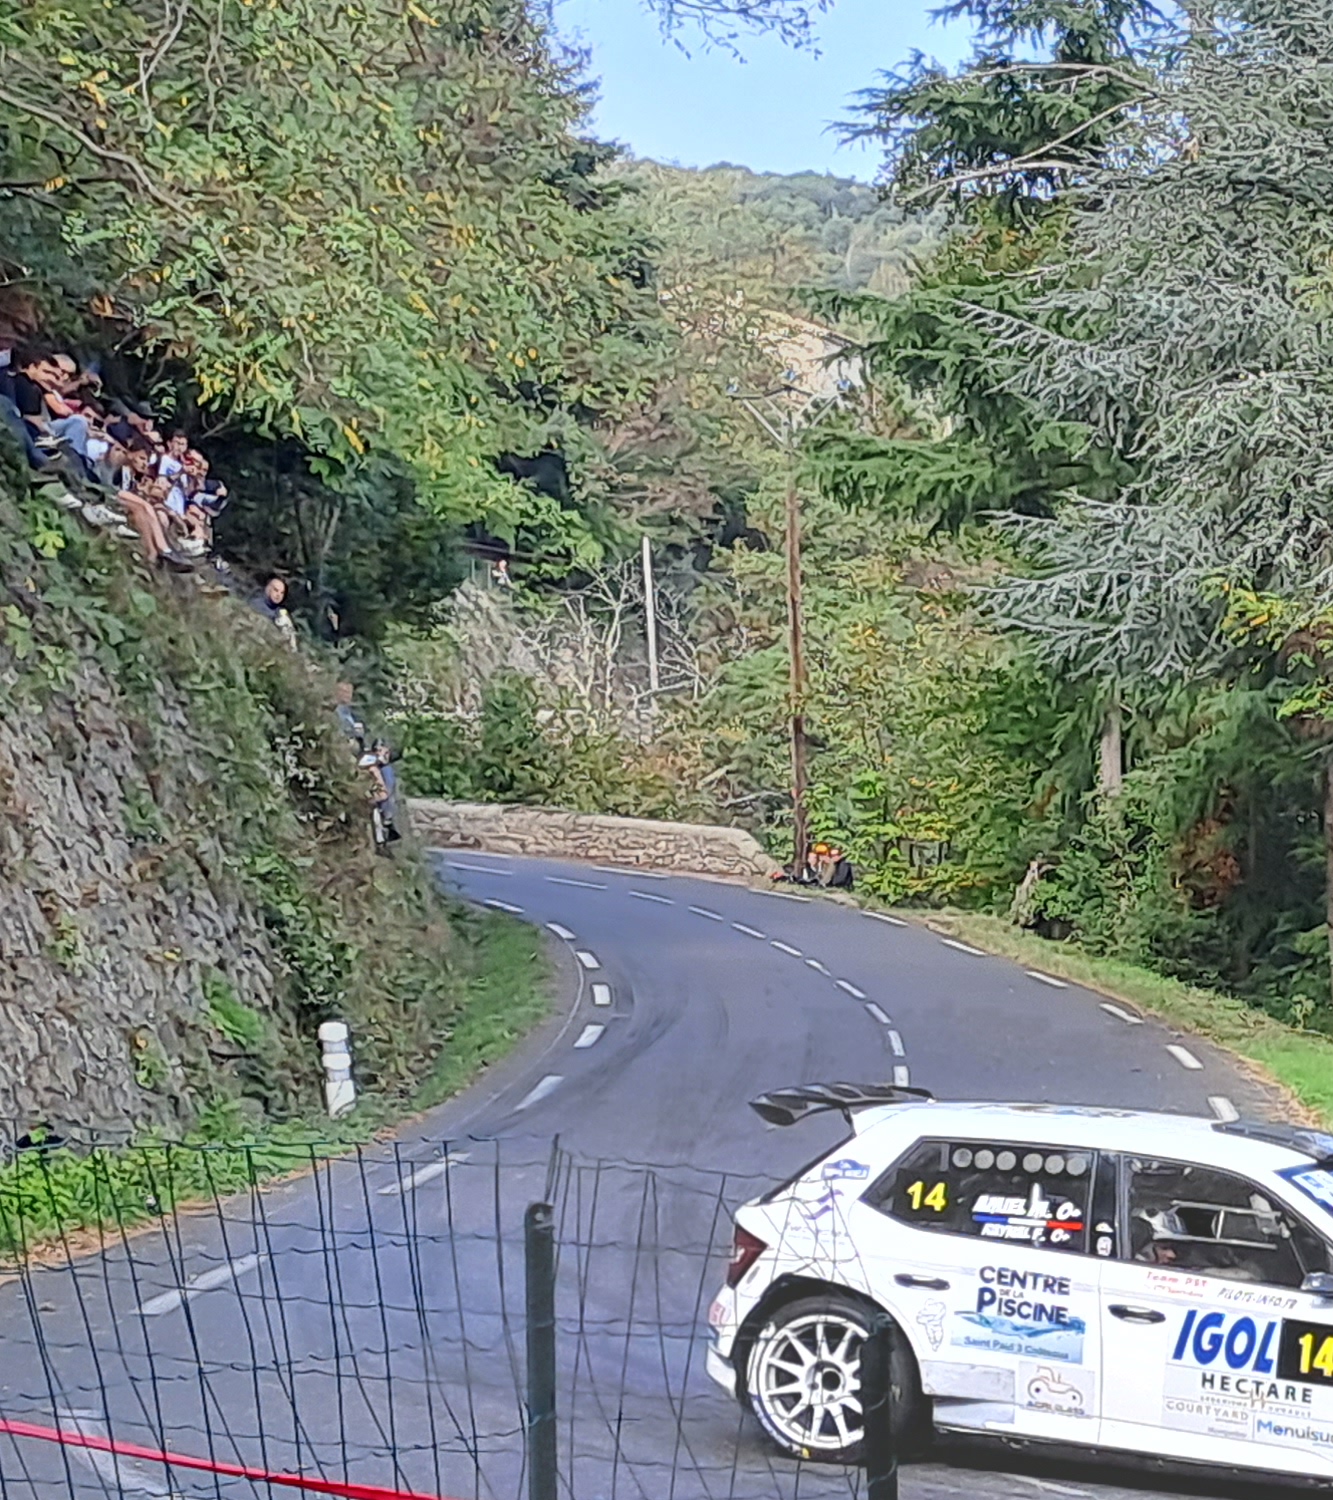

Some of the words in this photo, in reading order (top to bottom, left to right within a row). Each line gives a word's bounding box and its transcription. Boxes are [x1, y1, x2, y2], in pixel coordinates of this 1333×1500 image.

[907, 1181, 946, 1212] 14
[979, 1265, 1071, 1296] CENTRE
[999, 1288, 1011, 1298] DE
[1013, 1290, 1024, 1299] LA
[976, 1286, 1069, 1325] PISCINE
[1172, 1309, 1278, 1374] IGOL
[1201, 1372, 1313, 1404] HECTARE
[1166, 1401, 1249, 1421] COURTYARD
